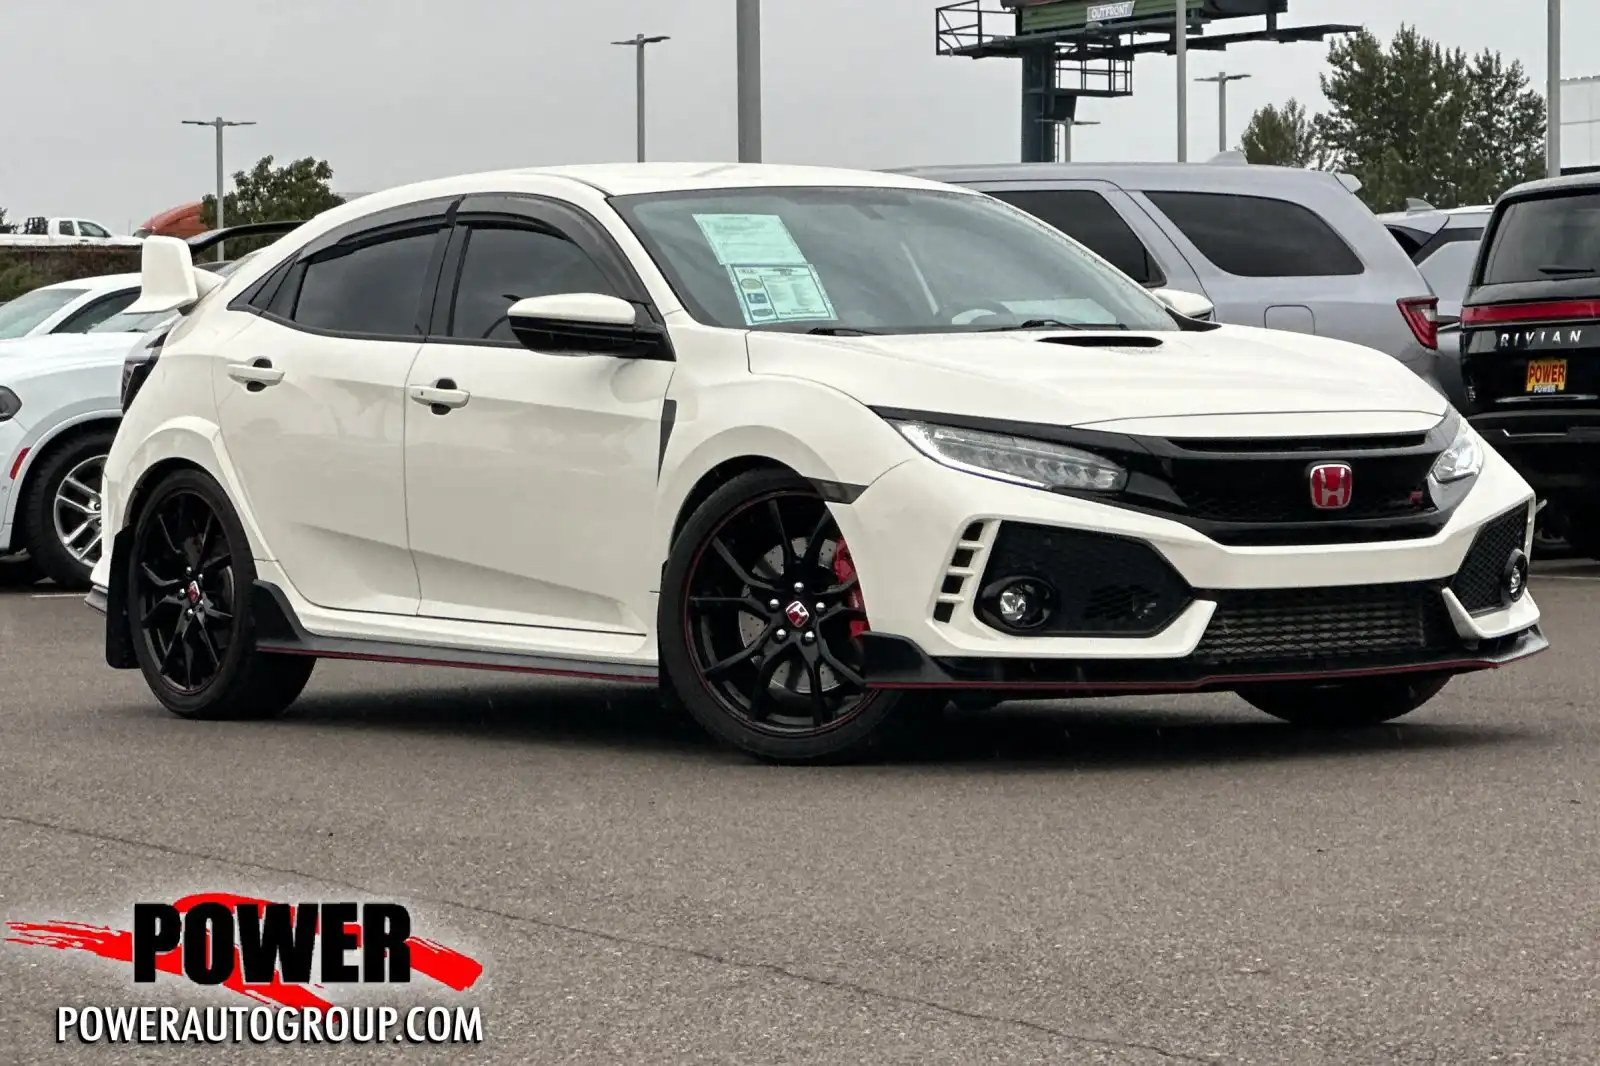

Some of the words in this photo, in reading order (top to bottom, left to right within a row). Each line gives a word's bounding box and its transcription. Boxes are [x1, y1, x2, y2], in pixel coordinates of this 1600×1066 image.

[1091, 4, 1129, 18] OUTFRONT
[1500, 330, 1581, 347] RIVIAN
[1528, 364, 1565, 384] POWER
[1533, 384, 1556, 393] POWER
